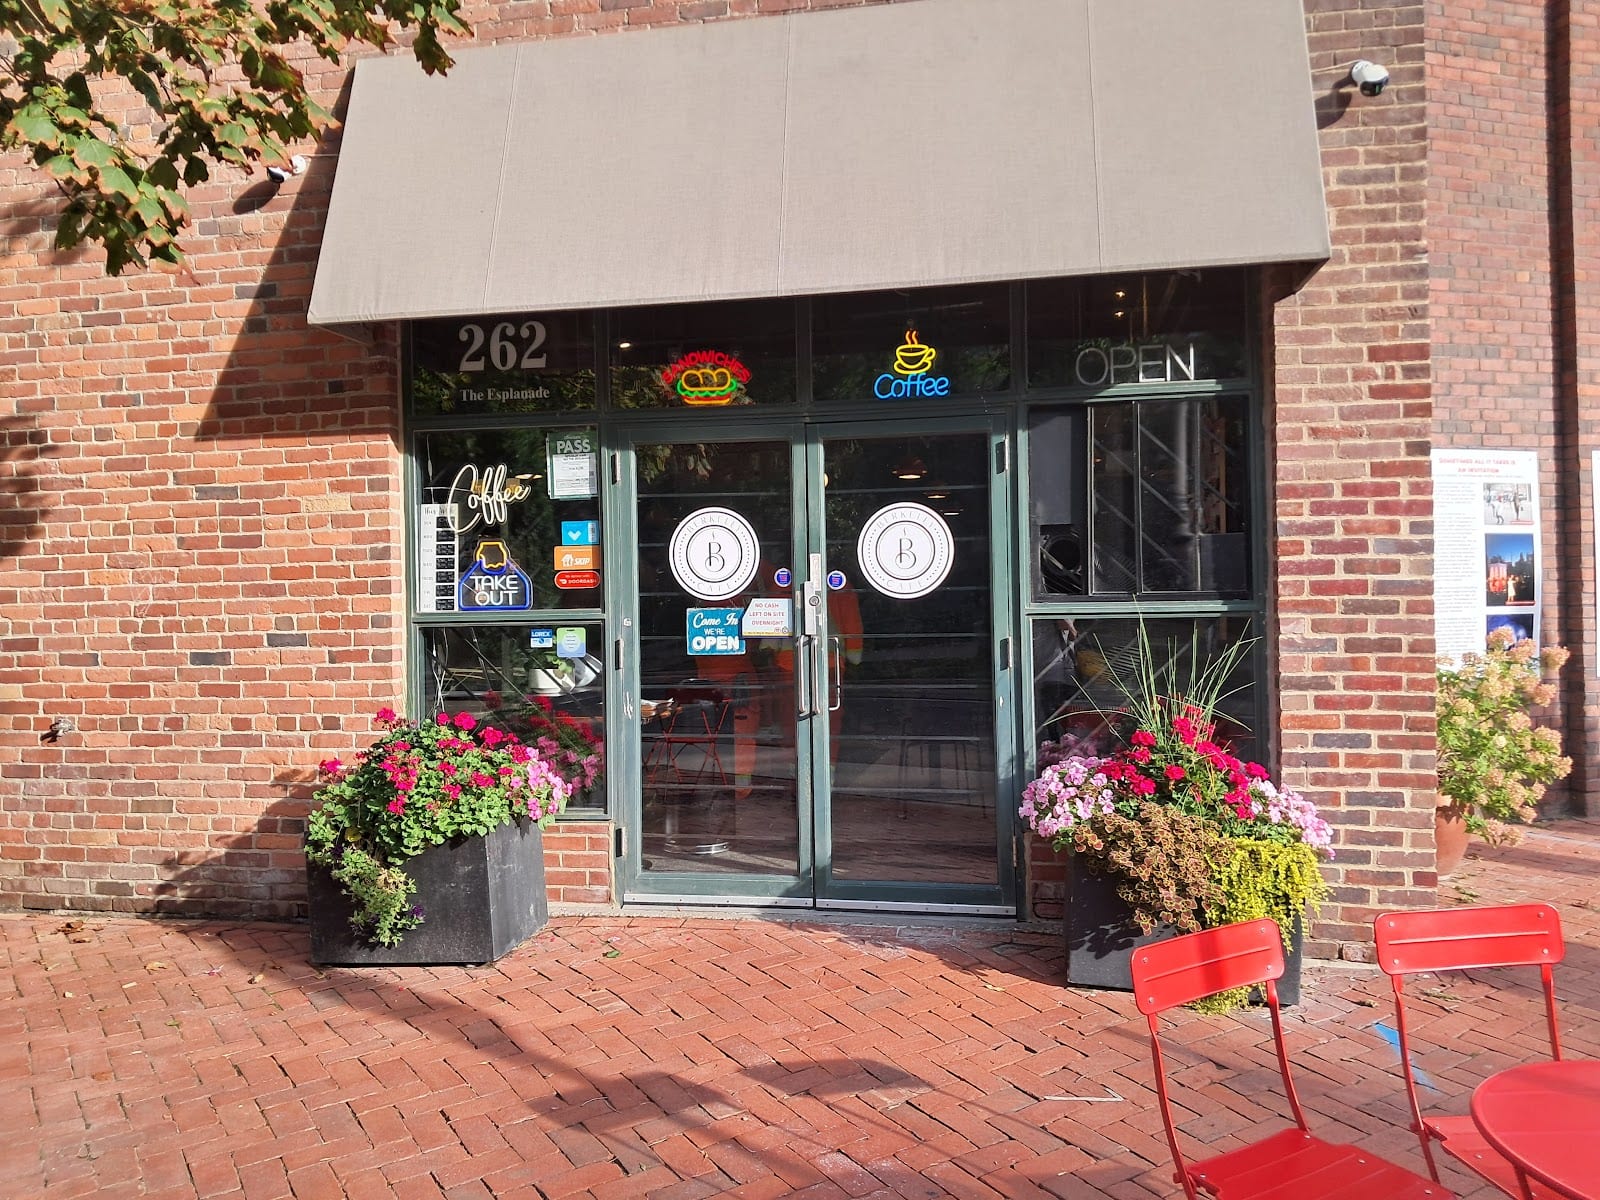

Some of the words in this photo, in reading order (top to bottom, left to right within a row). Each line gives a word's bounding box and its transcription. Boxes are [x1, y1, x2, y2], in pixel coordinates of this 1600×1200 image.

[458, 321, 547, 371] 262
[661, 350, 752, 384] SANDWICHES
[1075, 343, 1195, 385] OPEN
[873, 372, 950, 399] Coffee
[460, 389, 484, 401] The
[487, 386, 550, 403] Esplanade
[556, 439, 591, 454] PASS
[447, 464, 530, 534] Coffee
[574, 557, 591, 566] SKIP
[704, 541, 725, 573] B
[895, 537, 917, 570] B
[470, 575, 519, 591] TAKE
[475, 590, 518, 606] OUT
[693, 612, 721, 627] Come
[725, 612, 739, 626] In
[704, 627, 725, 635] WE'RE
[692, 635, 740, 651] OPEN
